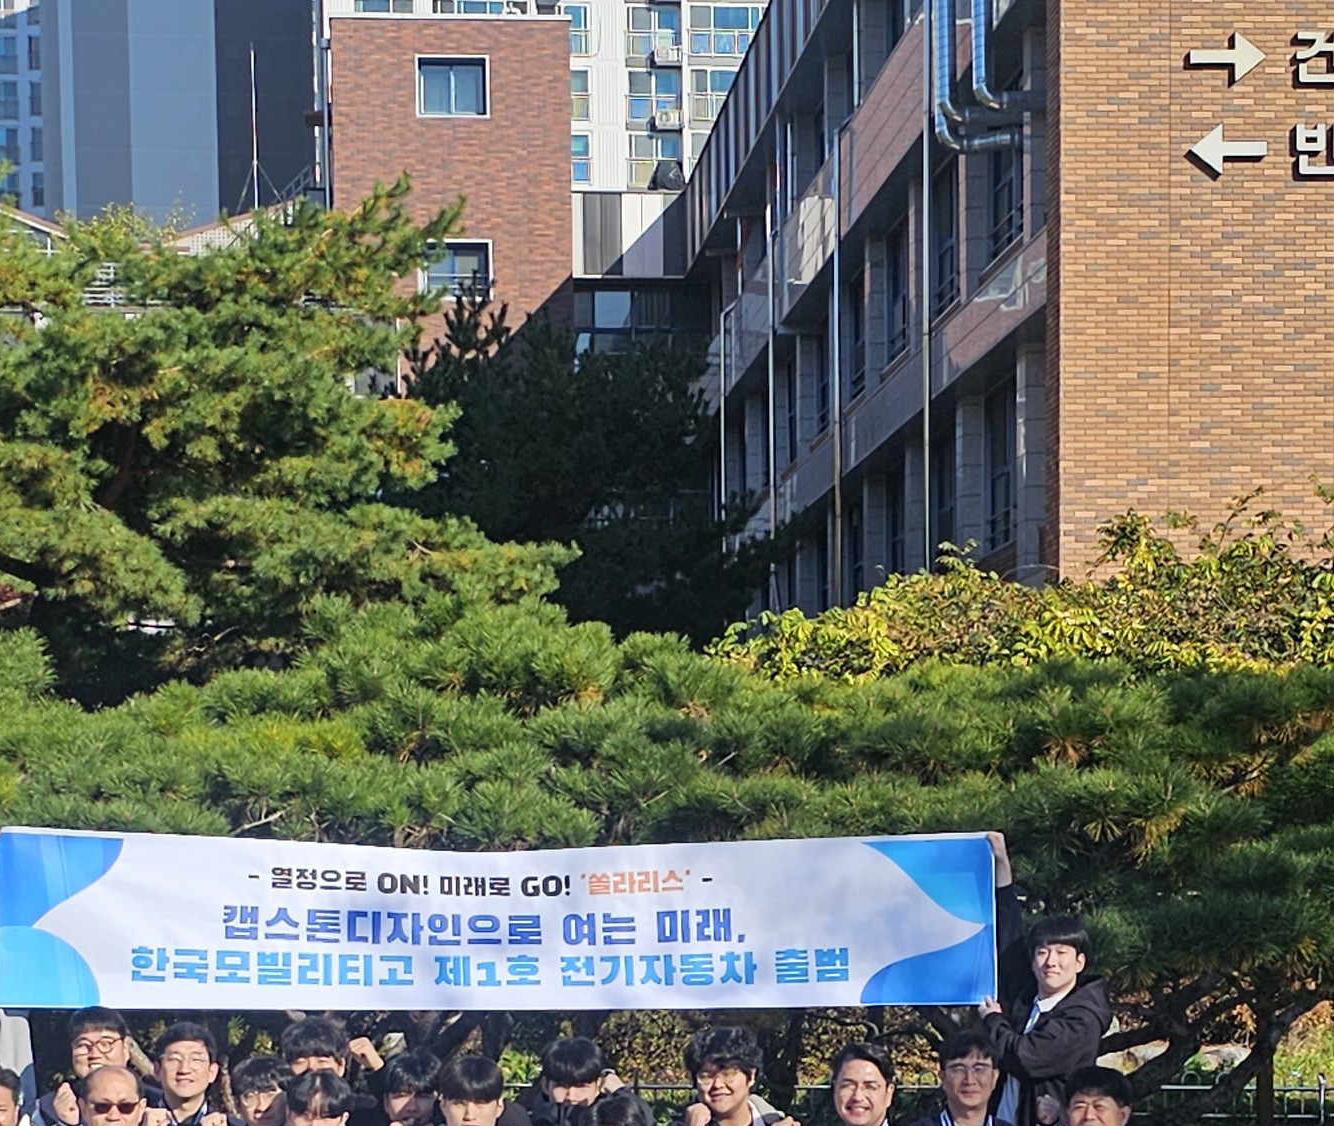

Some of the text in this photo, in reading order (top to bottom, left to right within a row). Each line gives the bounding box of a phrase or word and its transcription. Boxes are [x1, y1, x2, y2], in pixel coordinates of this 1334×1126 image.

[271, 866, 367, 892] 열정으로
[377, 872, 429, 896] ON!
[440, 874, 511, 897] 미래로
[521, 875, 571, 897] GO!
[222, 904, 746, 946] 캡스톤디자인으로 여는 미래,
[131, 946, 849, 987] 한국모빌리티고 제1호 전기자동차 출범
